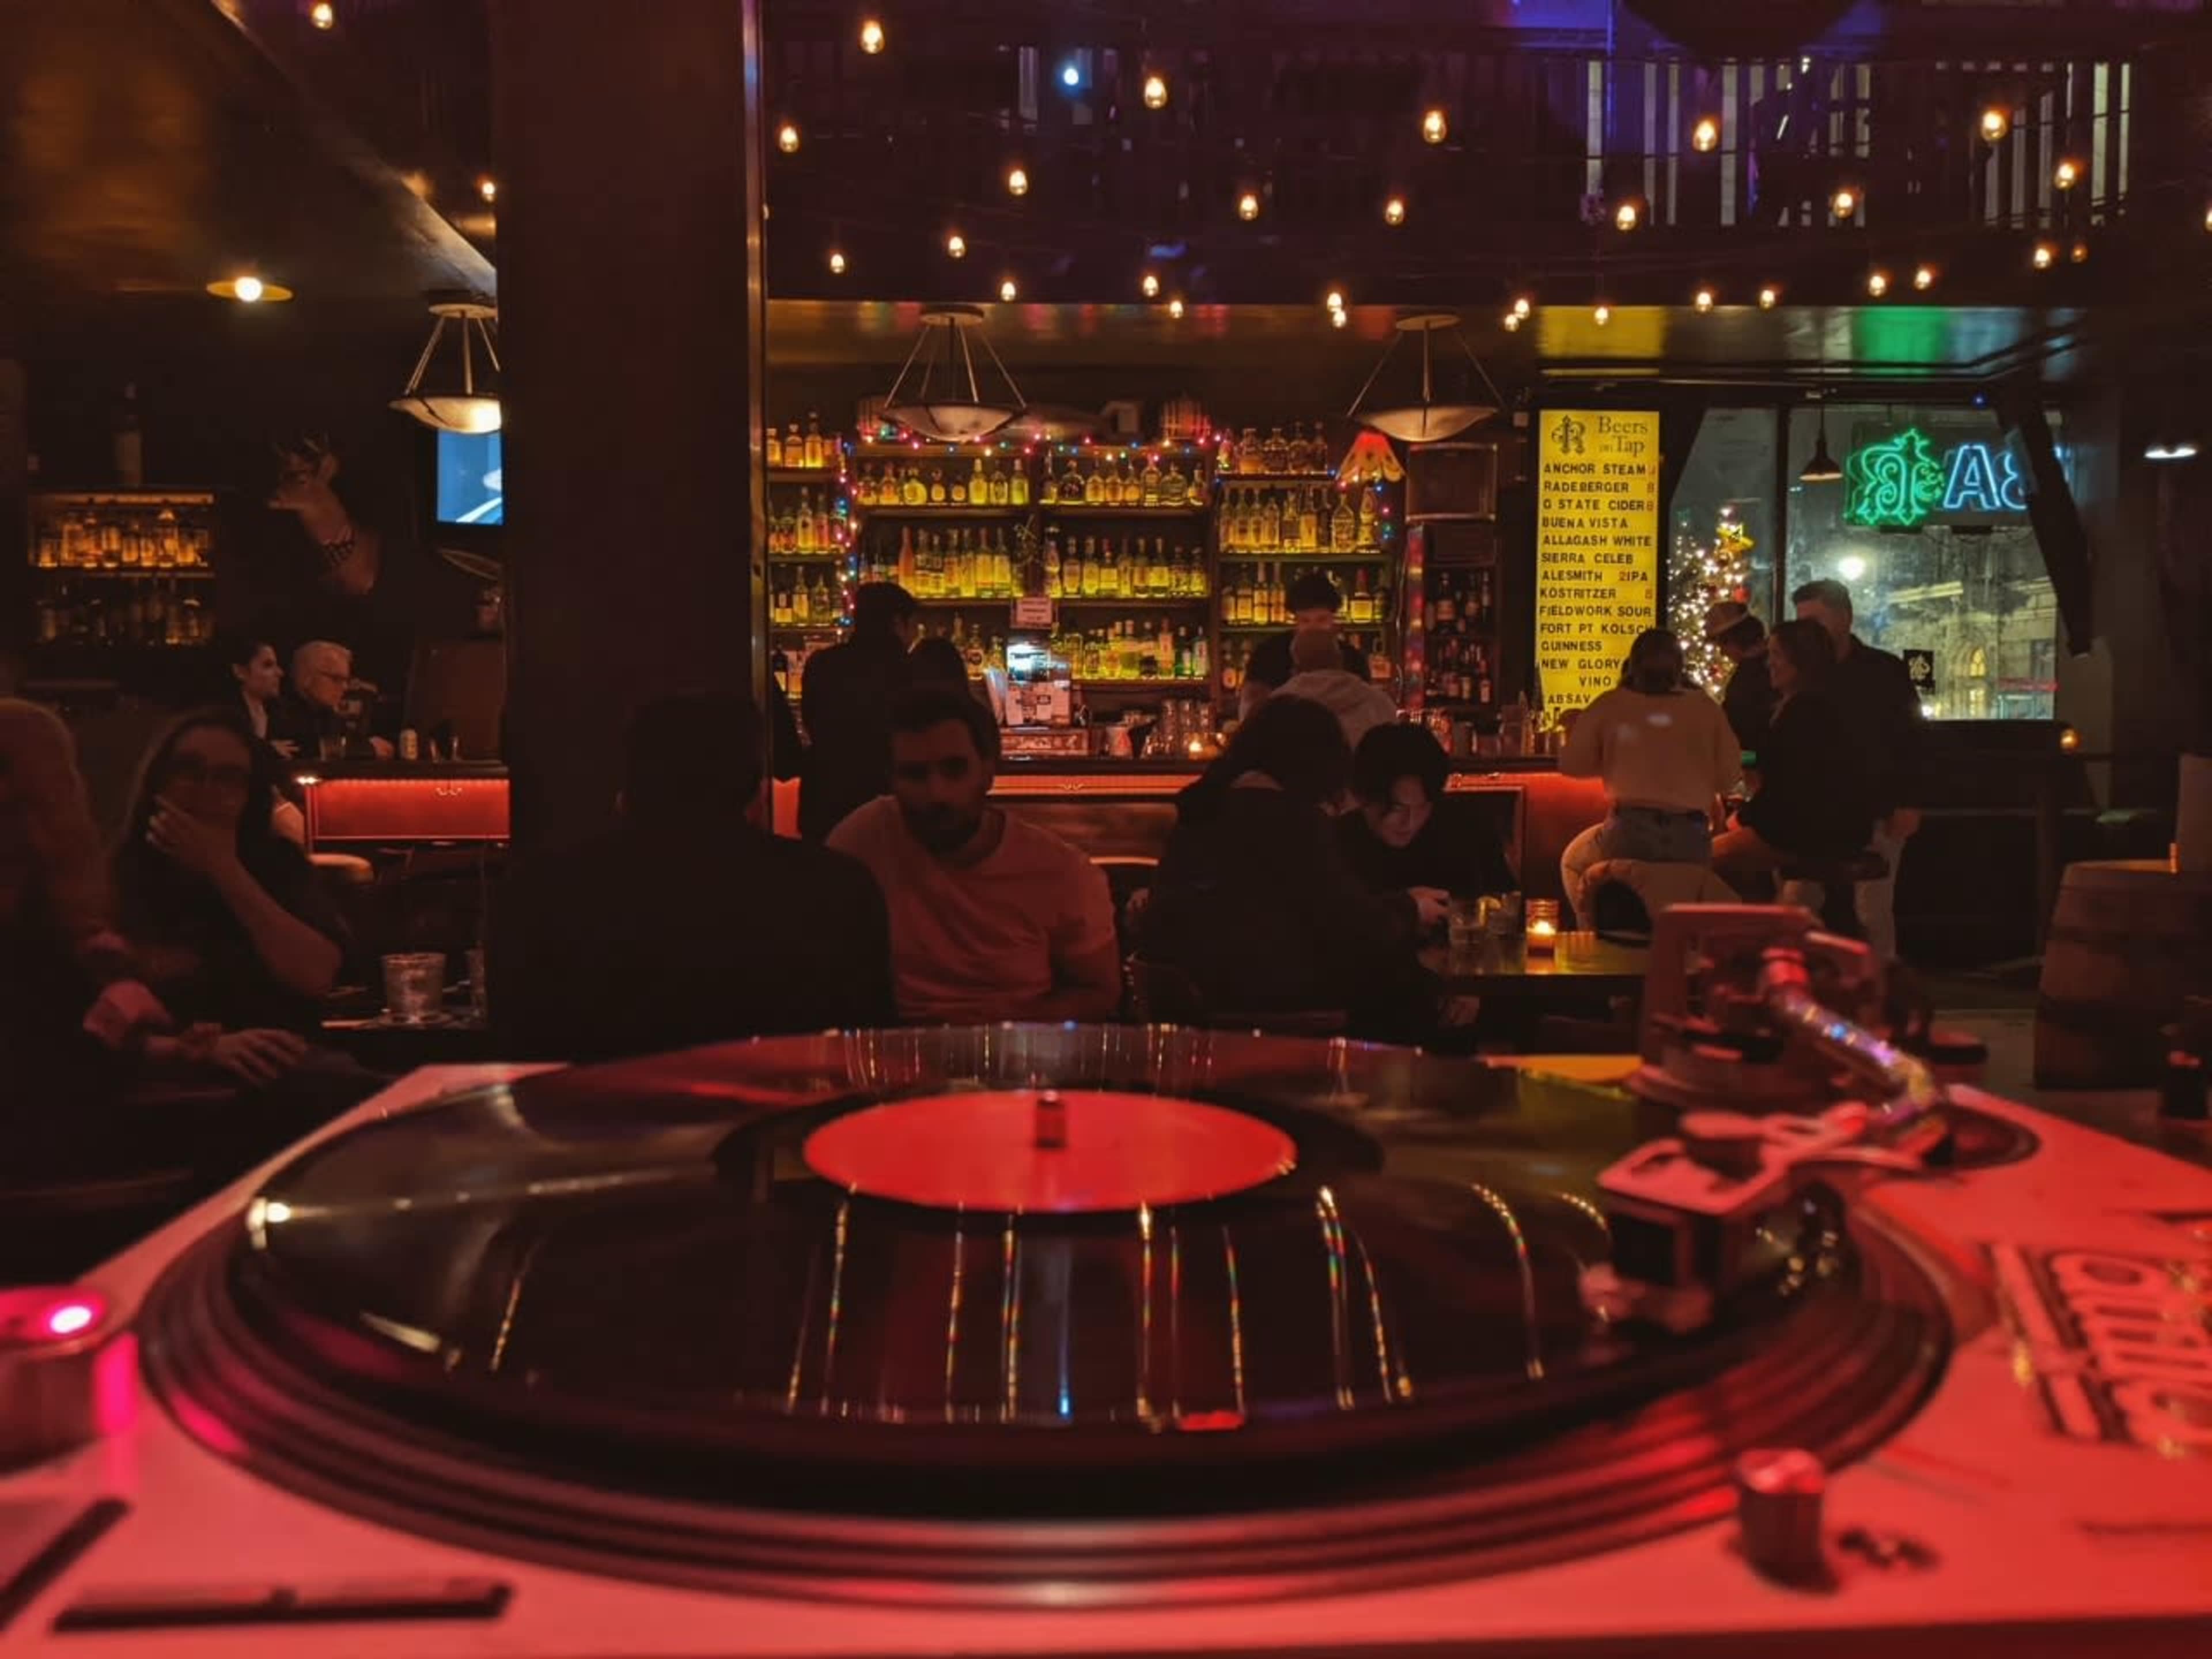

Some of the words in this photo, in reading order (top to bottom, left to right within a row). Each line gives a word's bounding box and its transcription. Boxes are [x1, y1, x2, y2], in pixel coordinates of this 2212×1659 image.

[1598, 415, 1648, 434] Beers
[1612, 434, 1645, 458] Tap
[1544, 463, 1595, 475] ANCHOR
[1603, 464, 1646, 475] STEAM
[1544, 481, 1629, 493] RADEBERGER
[1558, 499, 1600, 510] STATE
[1608, 499, 1645, 511] CIDER
[1541, 517, 1585, 529] BUENA
[1589, 517, 1628, 529] VISTA
[1543, 534, 1608, 546] ALLAGASH
[1612, 536, 1652, 547] WHITE
[1541, 552, 1585, 564] SIERRA
[1594, 553, 1634, 565] CELEB
[1541, 570, 1603, 582] ALESMITH
[1540, 588, 1616, 599] KOSTRITZER
[1540, 606, 1612, 616] FIELDWORK
[1616, 606, 1652, 618] SOUR
[1540, 623, 1572, 634] FORT
[1579, 624, 1593, 634] PT
[1540, 641, 1603, 652] GUINNESS
[1541, 658, 1569, 669] NEW
[1578, 658, 1620, 670] GLORY
[1579, 676, 1612, 687] VINO
